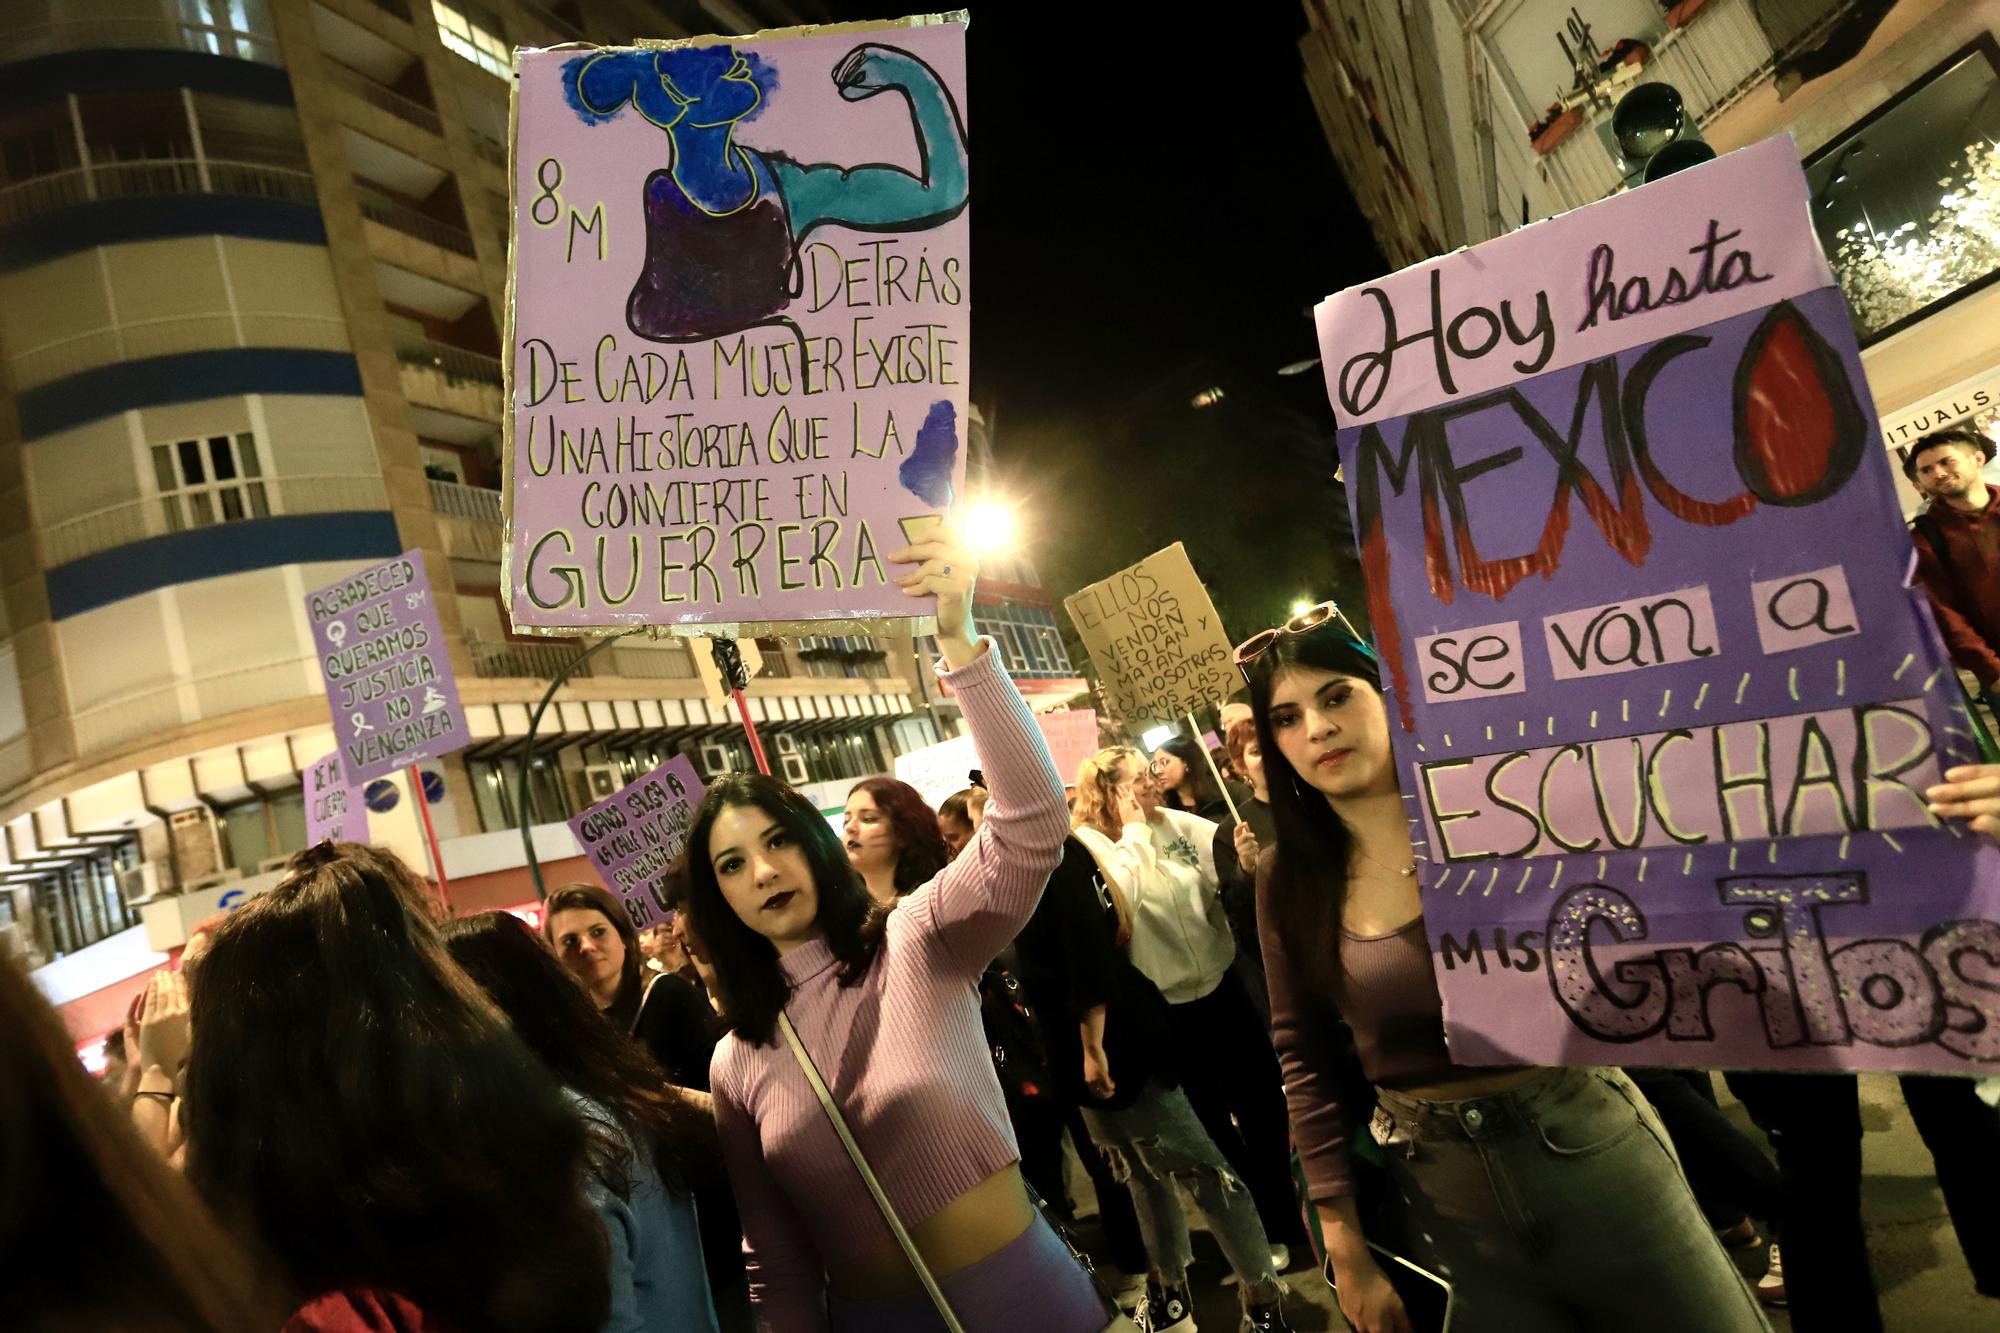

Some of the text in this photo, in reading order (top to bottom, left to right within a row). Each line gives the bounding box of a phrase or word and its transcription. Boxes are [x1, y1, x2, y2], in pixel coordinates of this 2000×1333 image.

[806, 239, 961, 313] DETRÁS
[1338, 219, 1773, 416] Hoy hasta
[523, 317, 960, 407] DE CADA MUJER EXISTE
[527, 401, 904, 477] UNA HISTORIA QUE LA
[1887, 391, 1990, 444] ITUALS
[1353, 297, 1868, 605] MEXICO
[581, 470, 848, 529] CONVIERTE EN
[312, 561, 414, 621] AGRADECED
[525, 518, 888, 611] GUERRERA
[356, 602, 395, 633] QUE
[1073, 565, 1158, 630] ELLOS
[1127, 590, 1179, 629] NOS
[326, 622, 429, 679] QUERAMOS
[1101, 607, 1184, 659] VENDEN
[1109, 626, 1189, 674] VIOLAN
[1424, 577, 1853, 694] se van a
[1117, 645, 1184, 689] MATAN
[1127, 667, 1220, 724] SOMOS LAS
[1140, 643, 1227, 696] NOSOTRAS
[349, 710, 453, 766] VENGANZA
[386, 696, 411, 723] NO
[666, 772, 686, 797] A
[1420, 704, 1945, 862] ESCUCHAR
[1440, 930, 1544, 974] MIS
